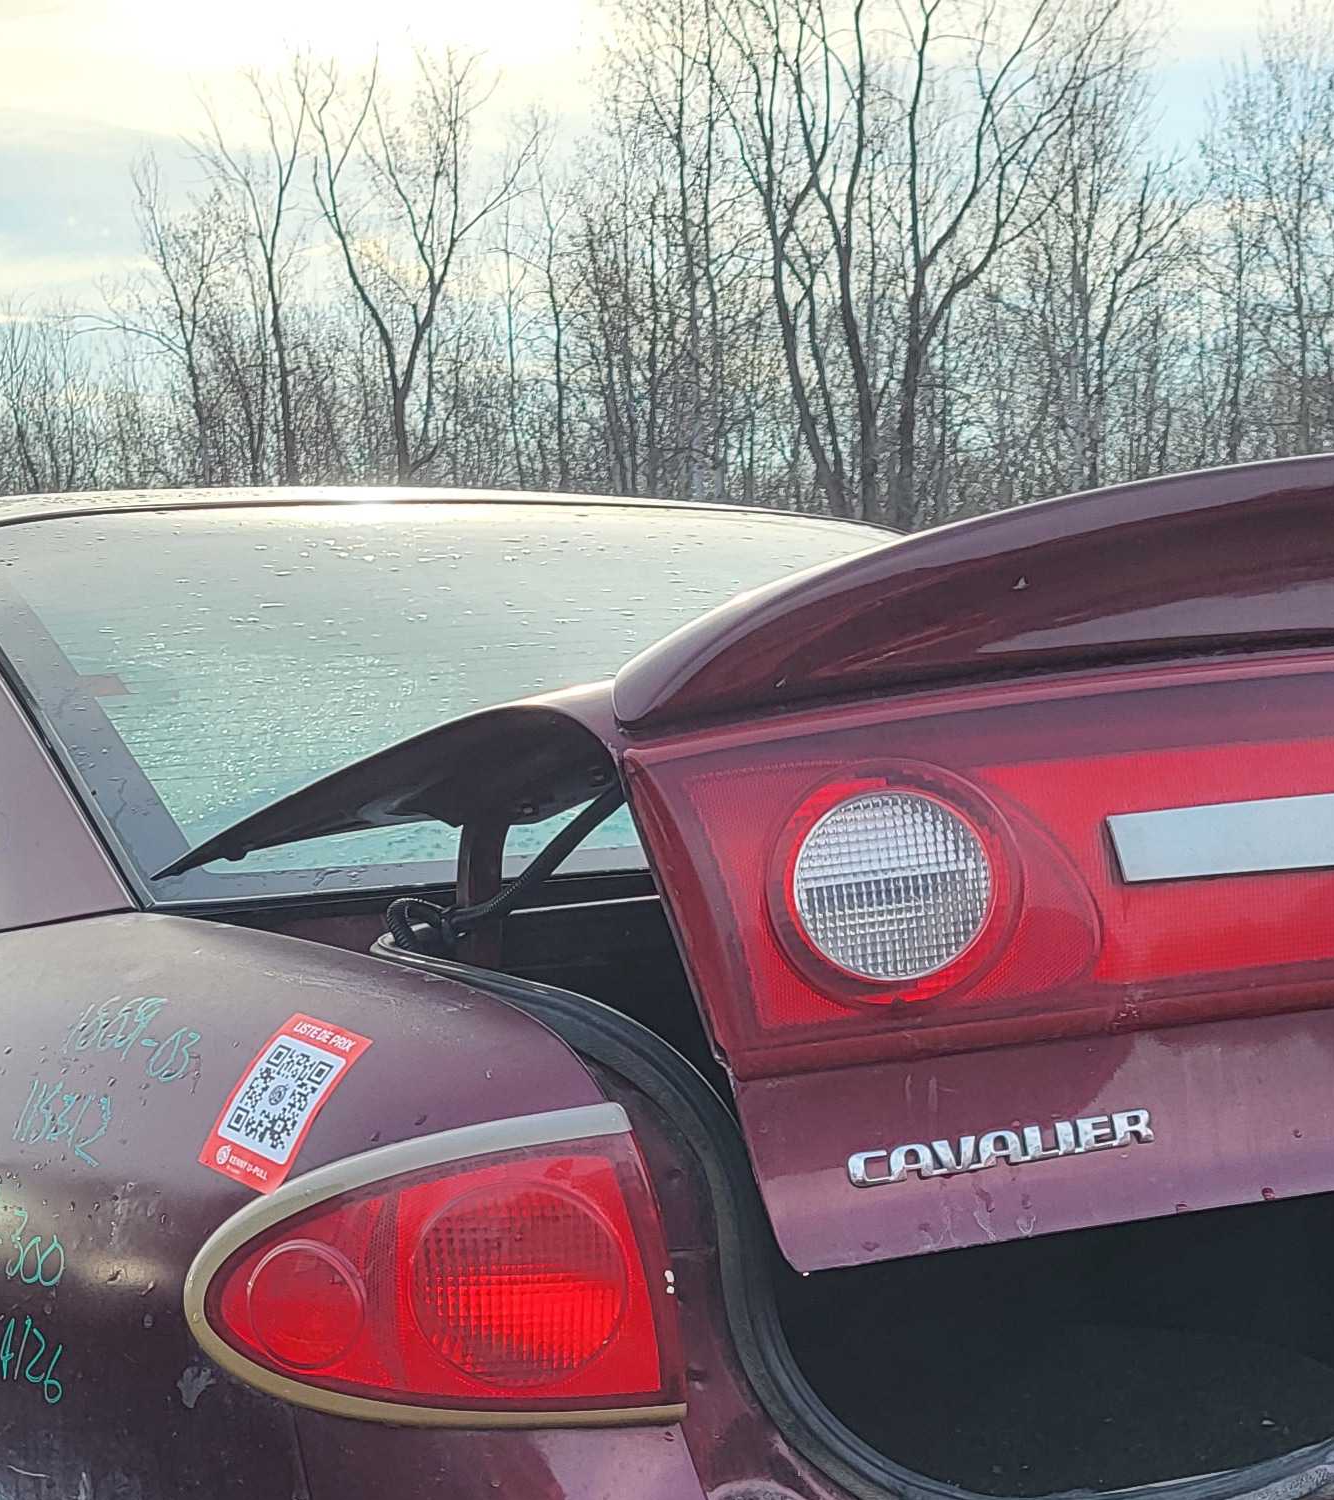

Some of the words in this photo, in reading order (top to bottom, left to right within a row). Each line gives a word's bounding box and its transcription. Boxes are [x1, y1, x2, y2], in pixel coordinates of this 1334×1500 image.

[293, 1021, 323, 1039] LISTE
[315, 1029, 335, 1043] DE
[328, 1034, 357, 1053] PRIX
[847, 1108, 1155, 1187] CAVALIER
